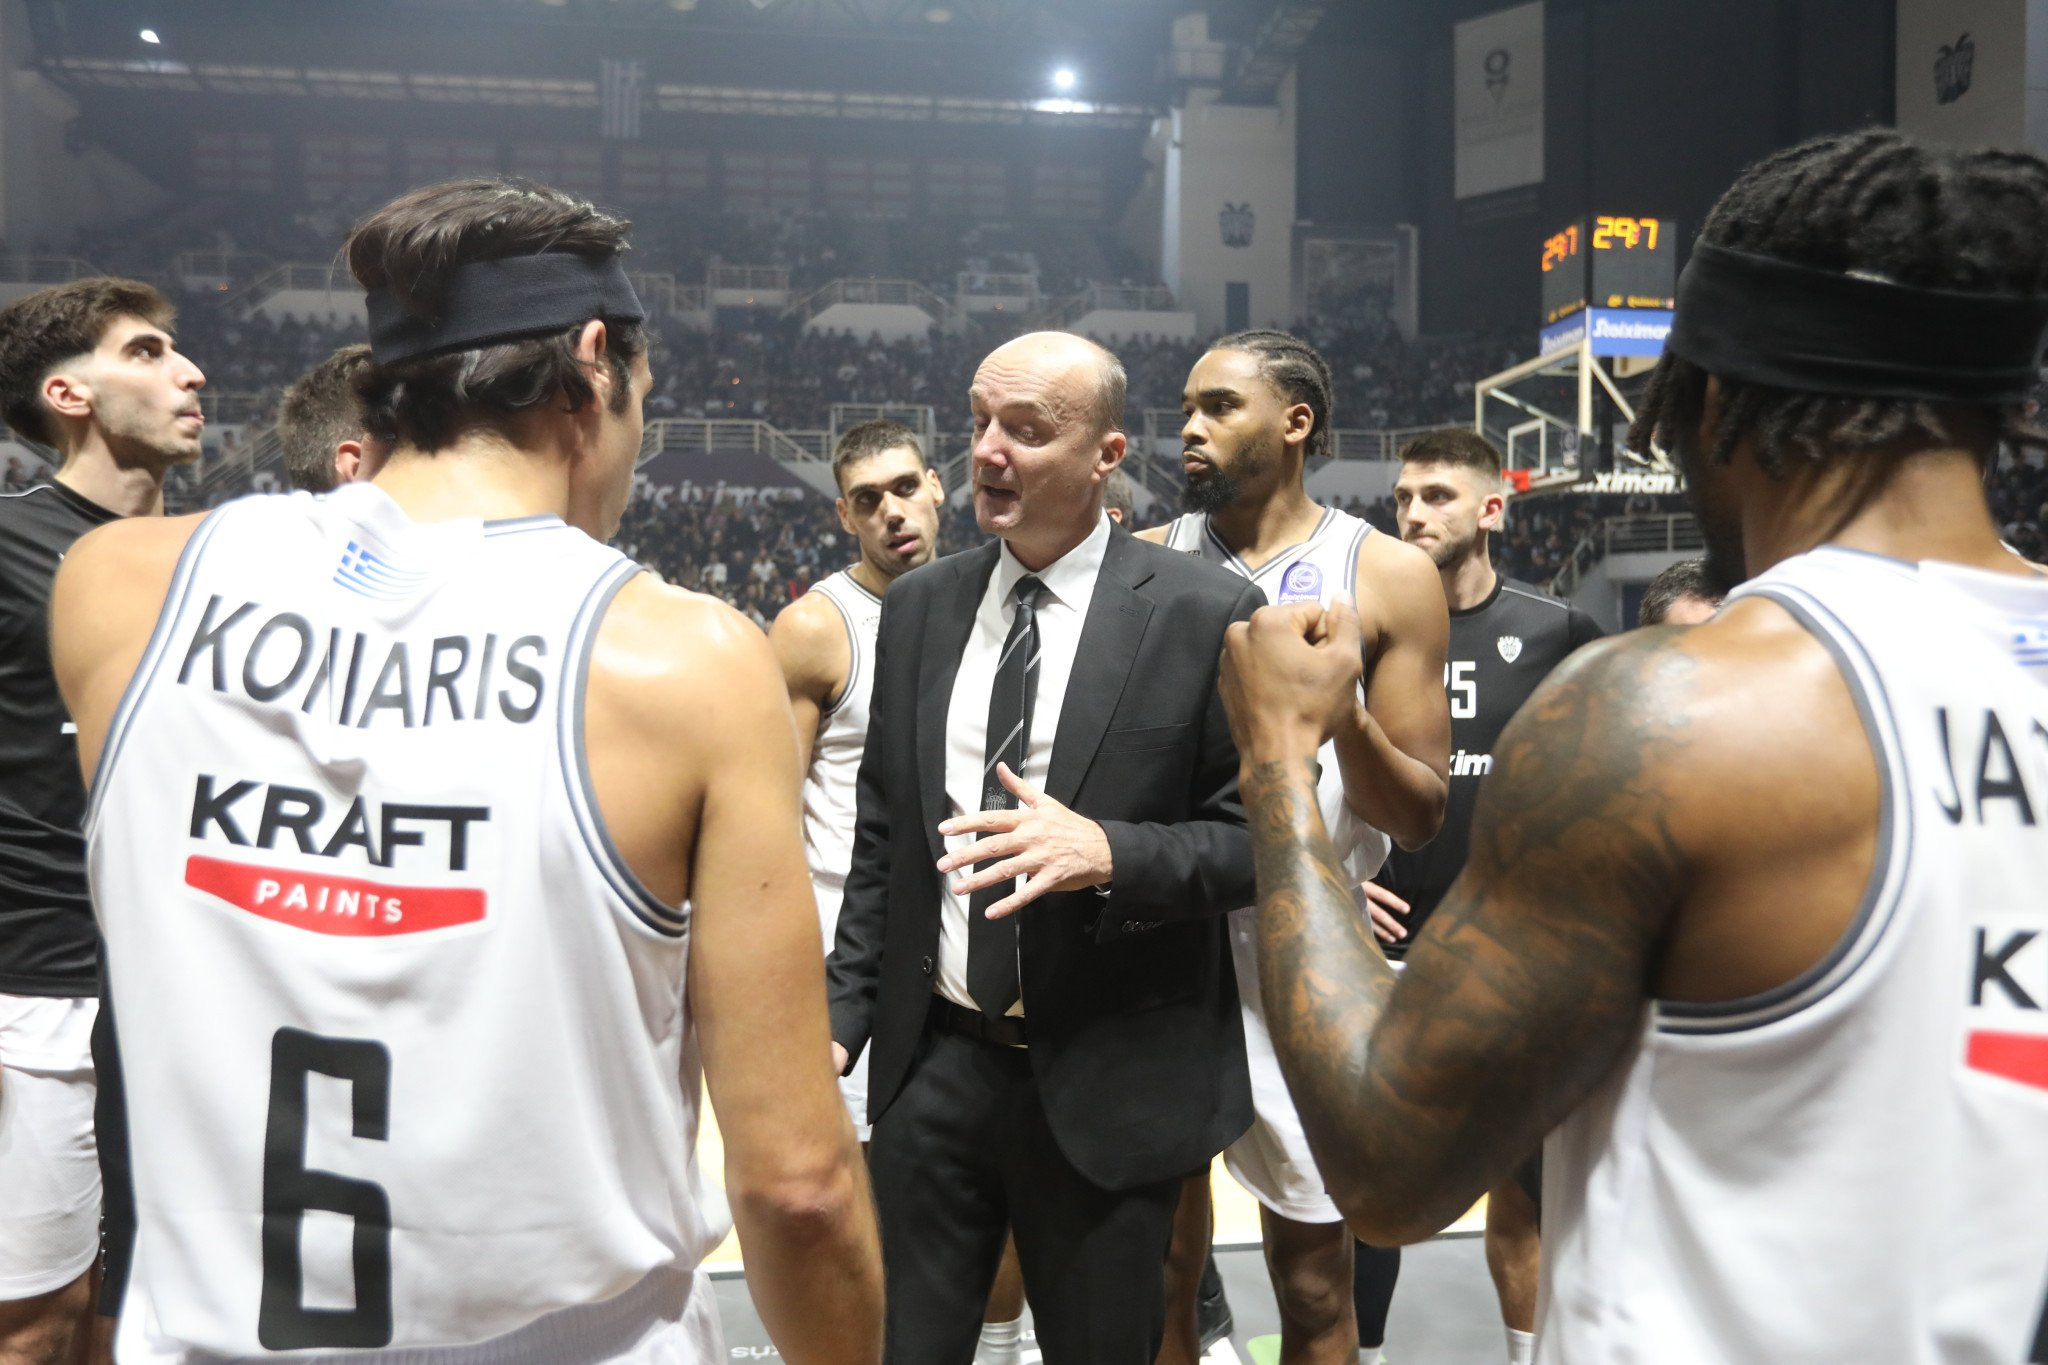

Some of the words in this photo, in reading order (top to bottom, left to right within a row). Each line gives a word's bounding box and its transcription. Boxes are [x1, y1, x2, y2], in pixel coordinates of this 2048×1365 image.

[1444, 661, 1476, 718] 5
[189, 773, 492, 872] KRAFT
[256, 878, 403, 923] PAINTS
[258, 1025, 393, 1351] 6
